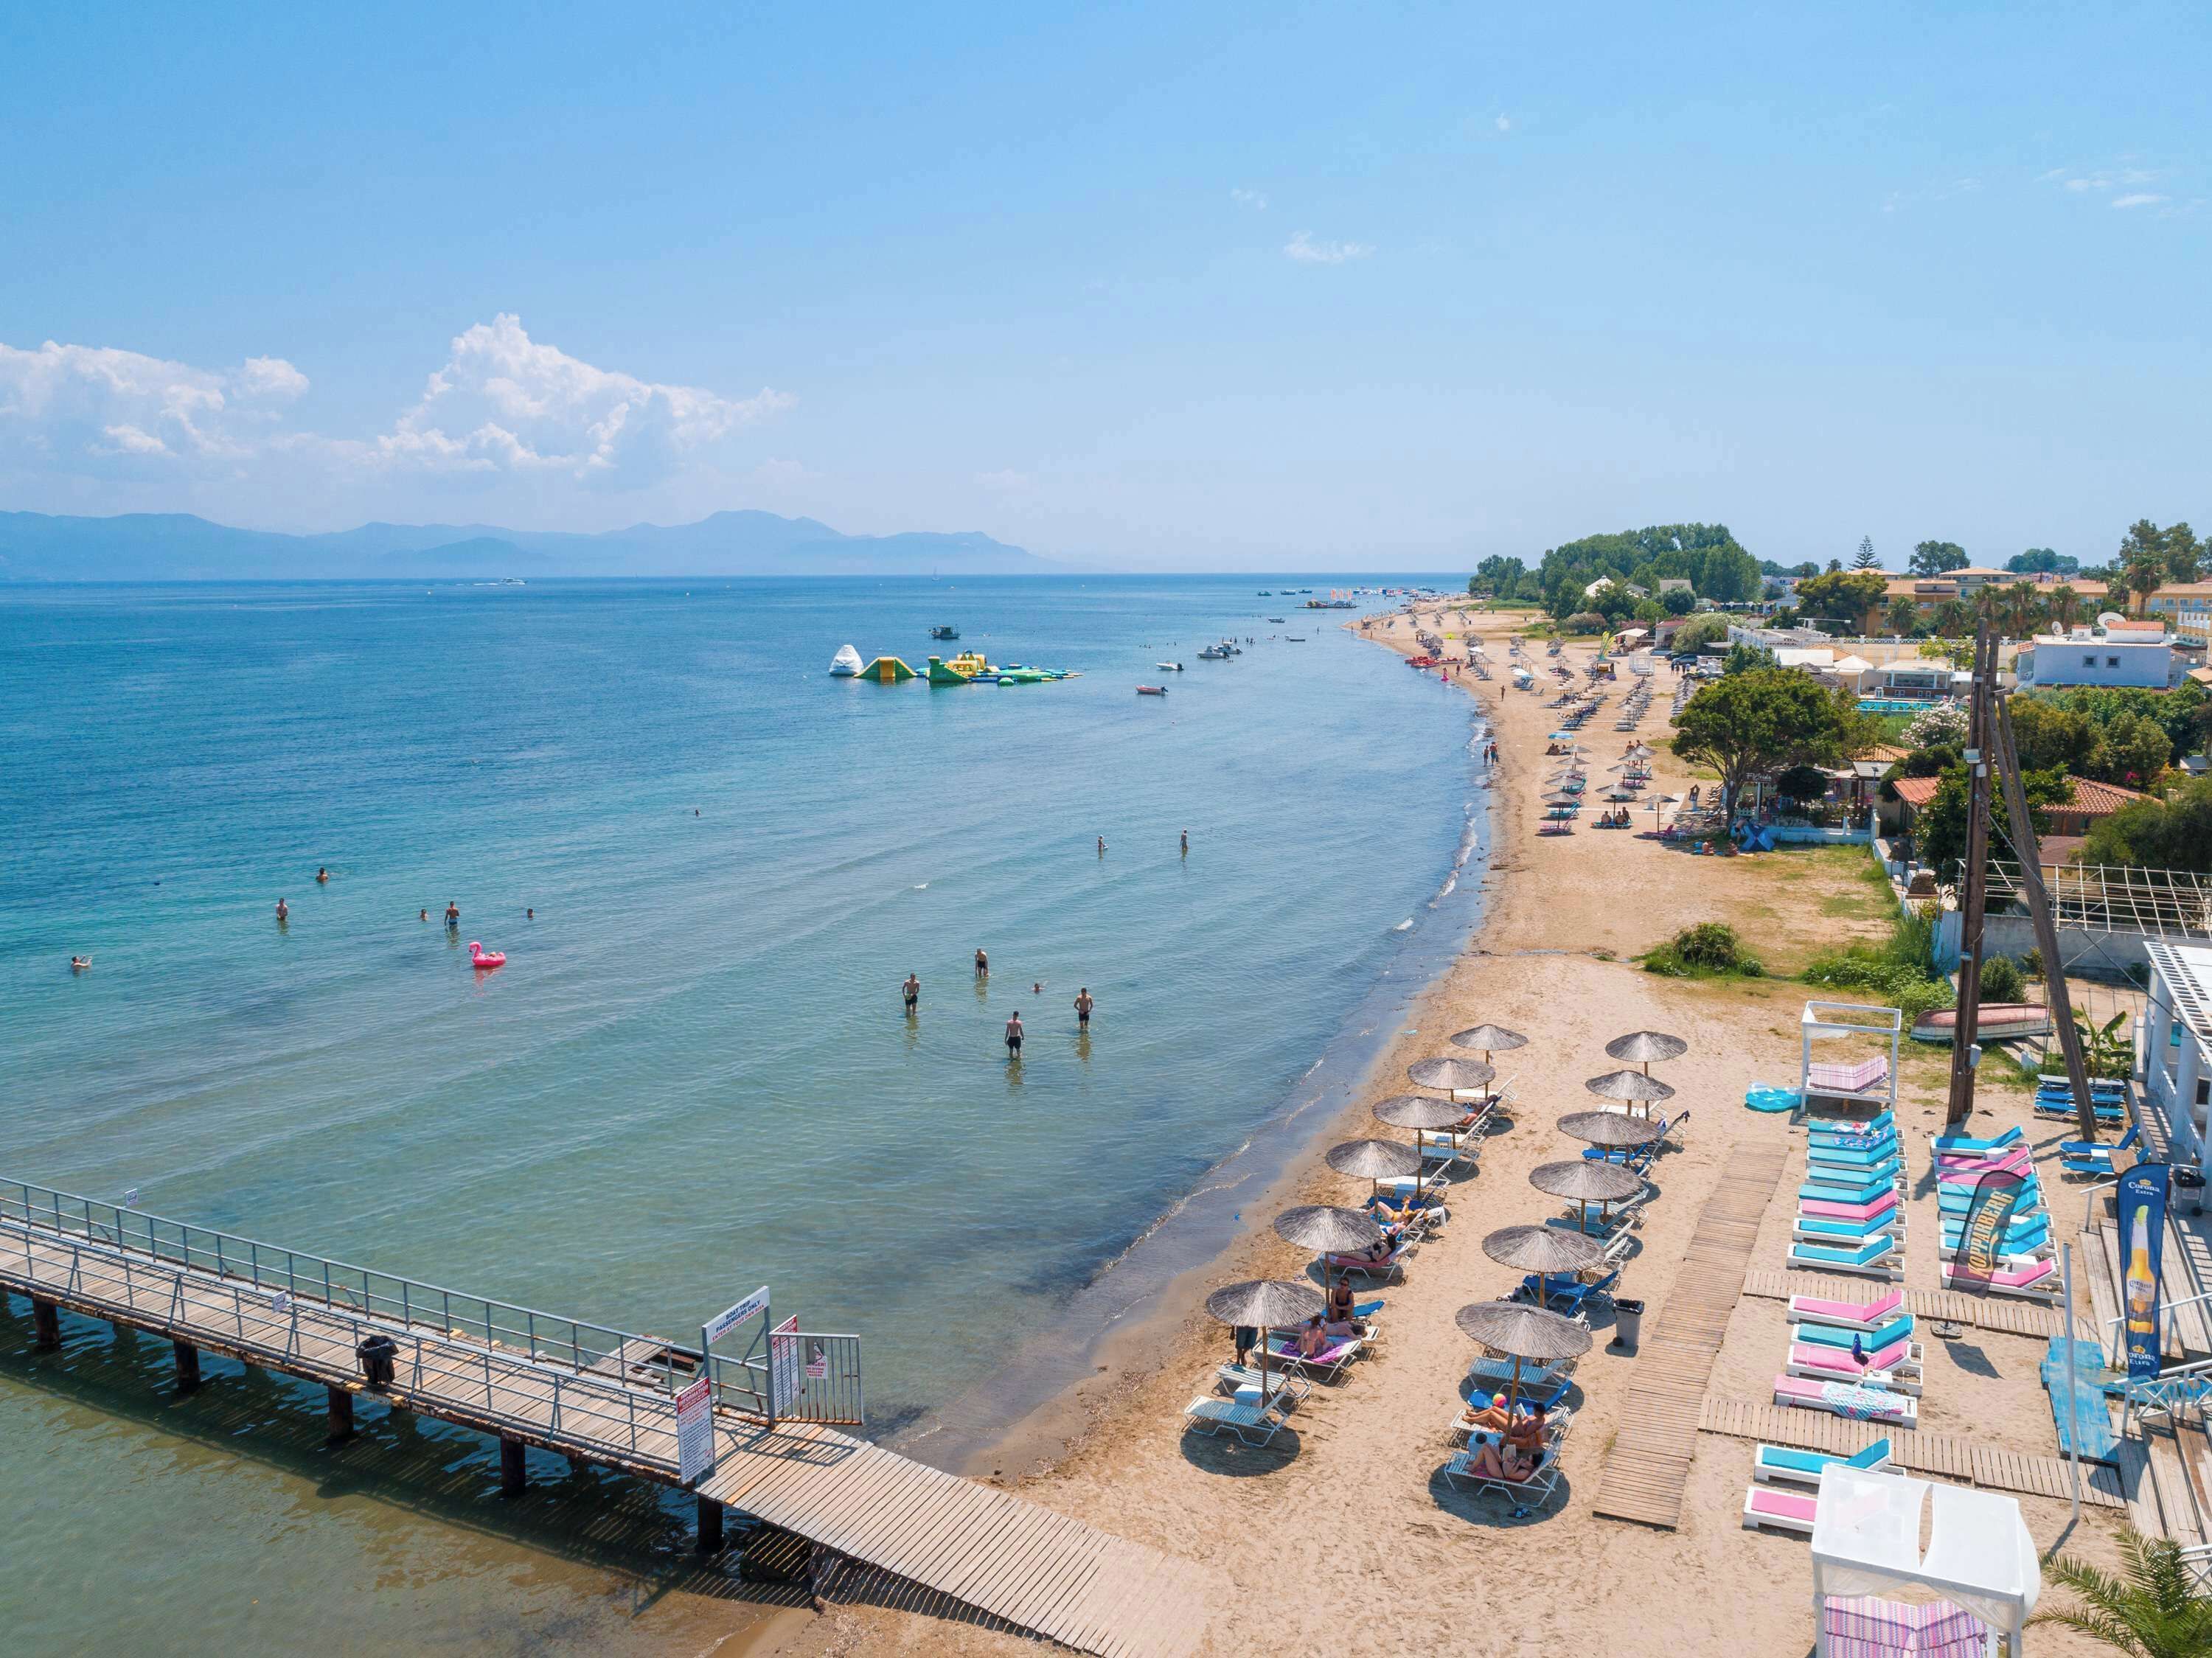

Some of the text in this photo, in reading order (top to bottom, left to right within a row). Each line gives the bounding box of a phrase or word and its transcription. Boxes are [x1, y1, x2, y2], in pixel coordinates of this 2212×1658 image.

[2128, 1181, 2160, 1192] Corona
[1964, 1206, 1981, 1251] PREMIUM CIDER
[1967, 1190, 2015, 1280] KOPPARBERG
[716, 1299, 760, 1332] PASSENGERS ONLY
[726, 1300, 751, 1320] BOAT TRIP
[712, 1329, 726, 1341] ENTER
[733, 1316, 745, 1327] YOUR
[745, 1311, 754, 1319] OWN
[2129, 1352, 2156, 1362] orona
[678, 1384, 709, 1407] INFORMATION
[680, 1381, 706, 1399] IMPORTANT
